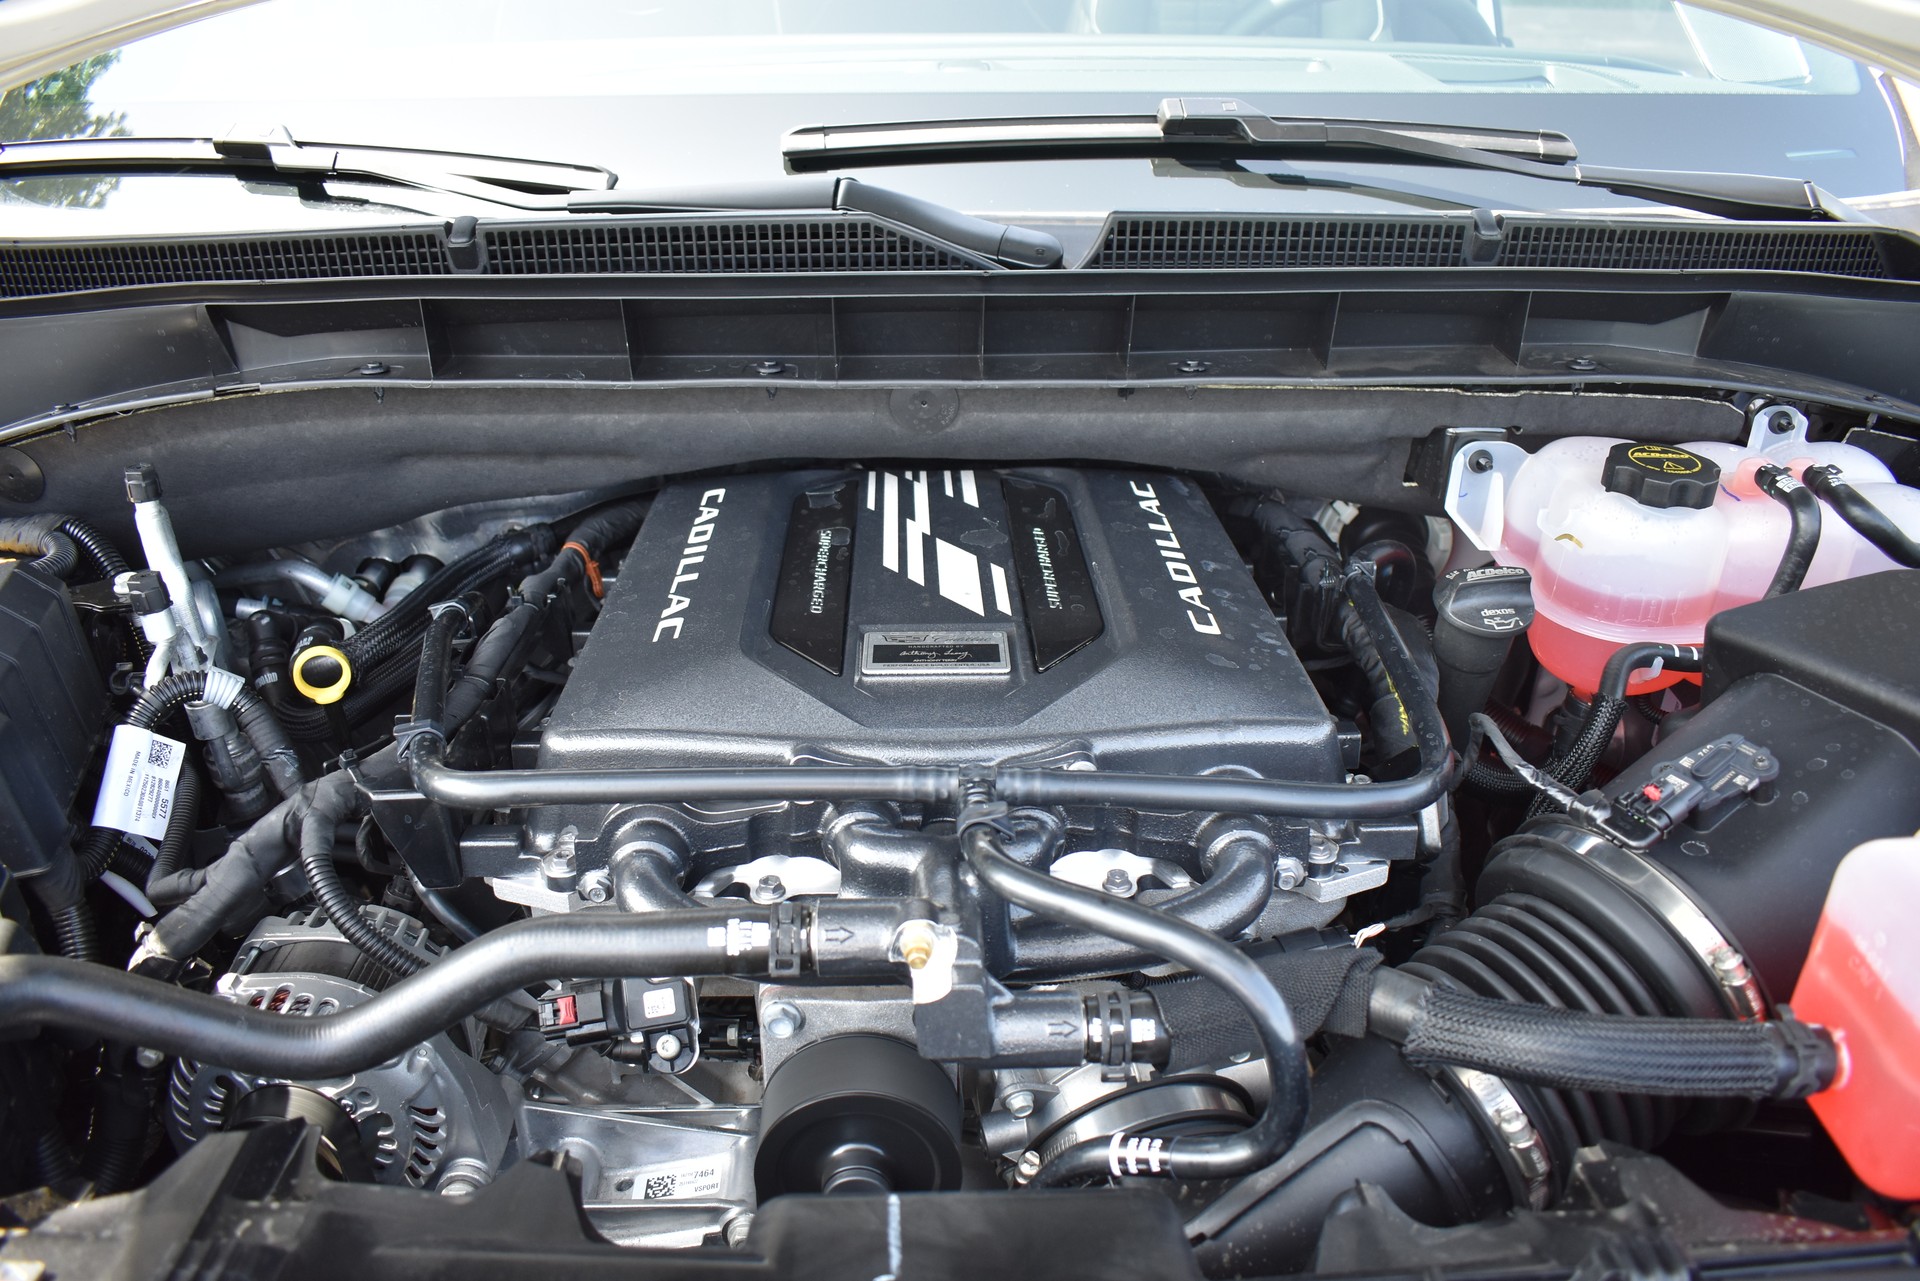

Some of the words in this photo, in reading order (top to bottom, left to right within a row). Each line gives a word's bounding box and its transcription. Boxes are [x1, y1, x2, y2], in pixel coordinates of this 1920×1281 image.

[652, 488, 726, 642] CADILLAC
[1129, 480, 1221, 635] CADILLAC
[810, 530, 832, 614] SUPERCHARGED
[1466, 567, 1524, 581] ACDelco
[1481, 608, 1516, 617] dexos
[132, 750, 141, 767] MADE
[123, 775, 133, 797] MEXICO
[158, 798, 169, 819] 5577
[693, 1168, 714, 1179] 7464
